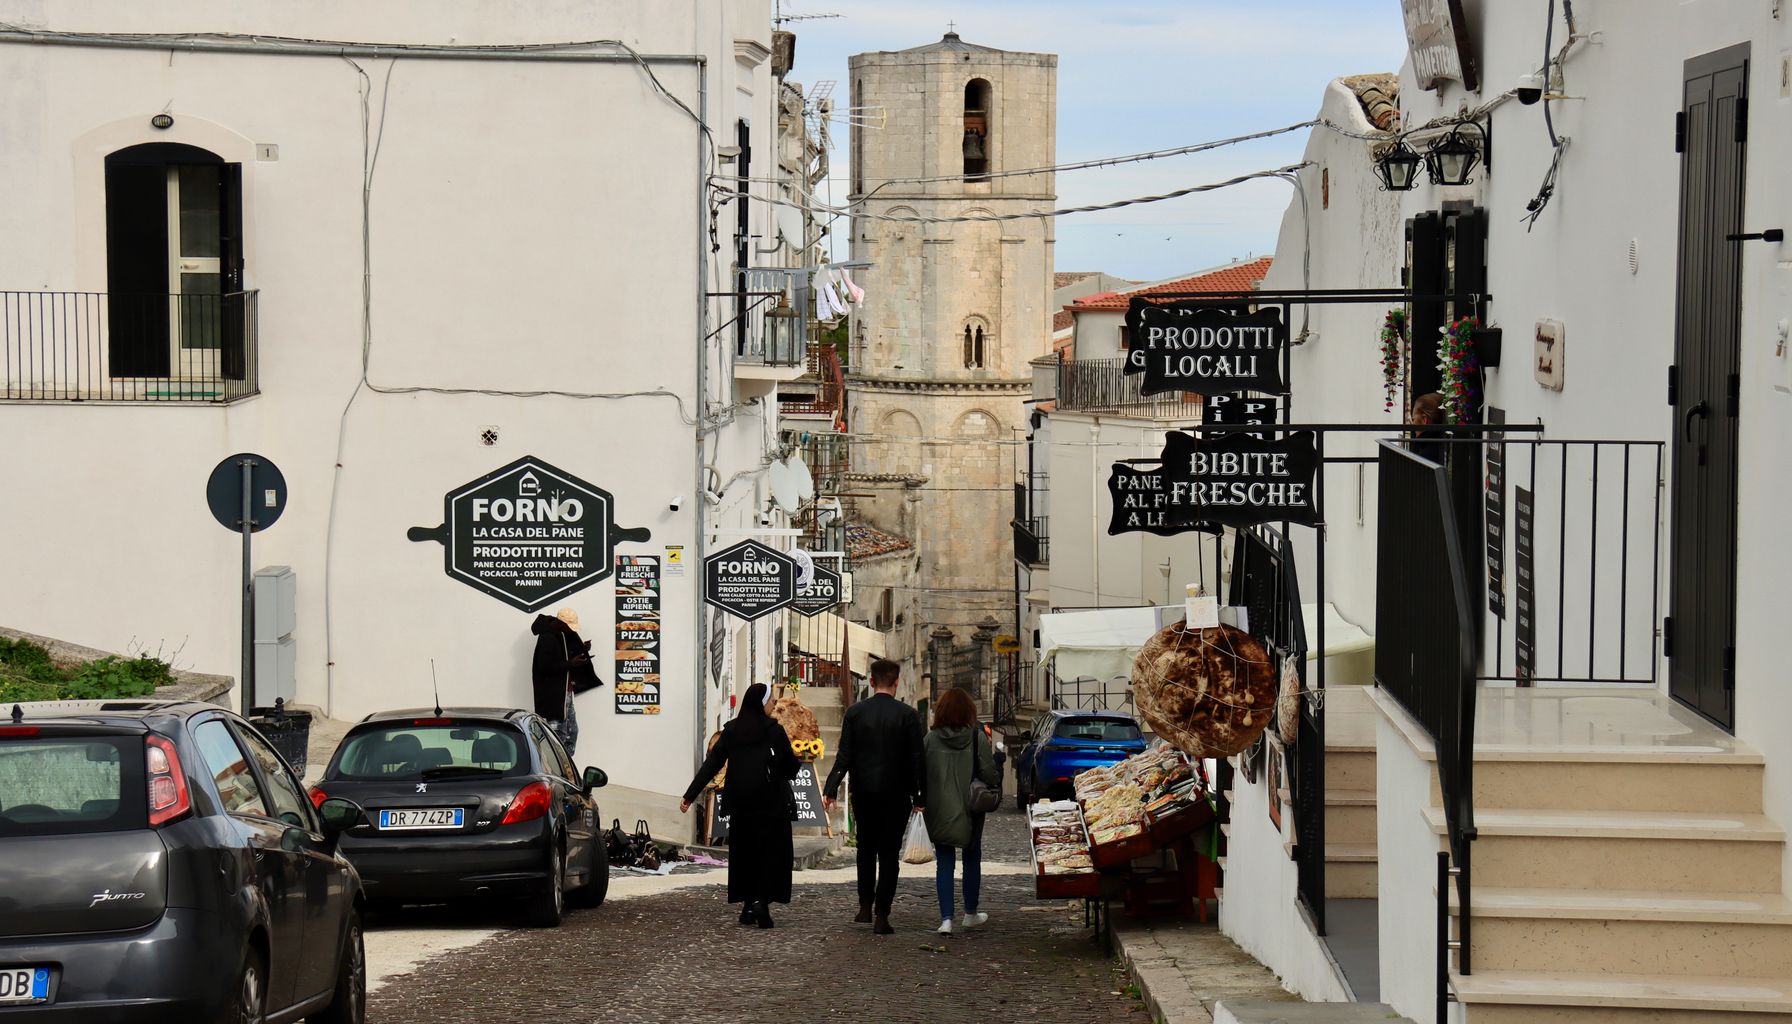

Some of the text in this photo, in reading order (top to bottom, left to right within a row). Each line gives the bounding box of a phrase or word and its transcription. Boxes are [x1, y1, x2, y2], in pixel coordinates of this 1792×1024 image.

[1148, 327, 1274, 350] PRODOTTI
[1164, 355, 1258, 378] LOCALI
[1189, 451, 1290, 476] BIBITE
[1117, 475, 1163, 490] PANE
[1123, 493, 1149, 508] AL
[1171, 481, 1307, 507] FRESCHE
[473, 498, 584, 522] FORNO
[1127, 512, 1141, 526] A
[473, 527, 584, 538] LA CASA DEL PANE
[473, 546, 583, 558] PRODOTTI TIPICI
[718, 561, 780, 575] FORNO
[515, 579, 542, 587] PANINI
[800, 586, 835, 597] STO
[621, 631, 654, 640] PIZZA
[617, 694, 657, 703] TARALLI
[796, 769, 811, 778] NO
[794, 792, 807, 800] NE
